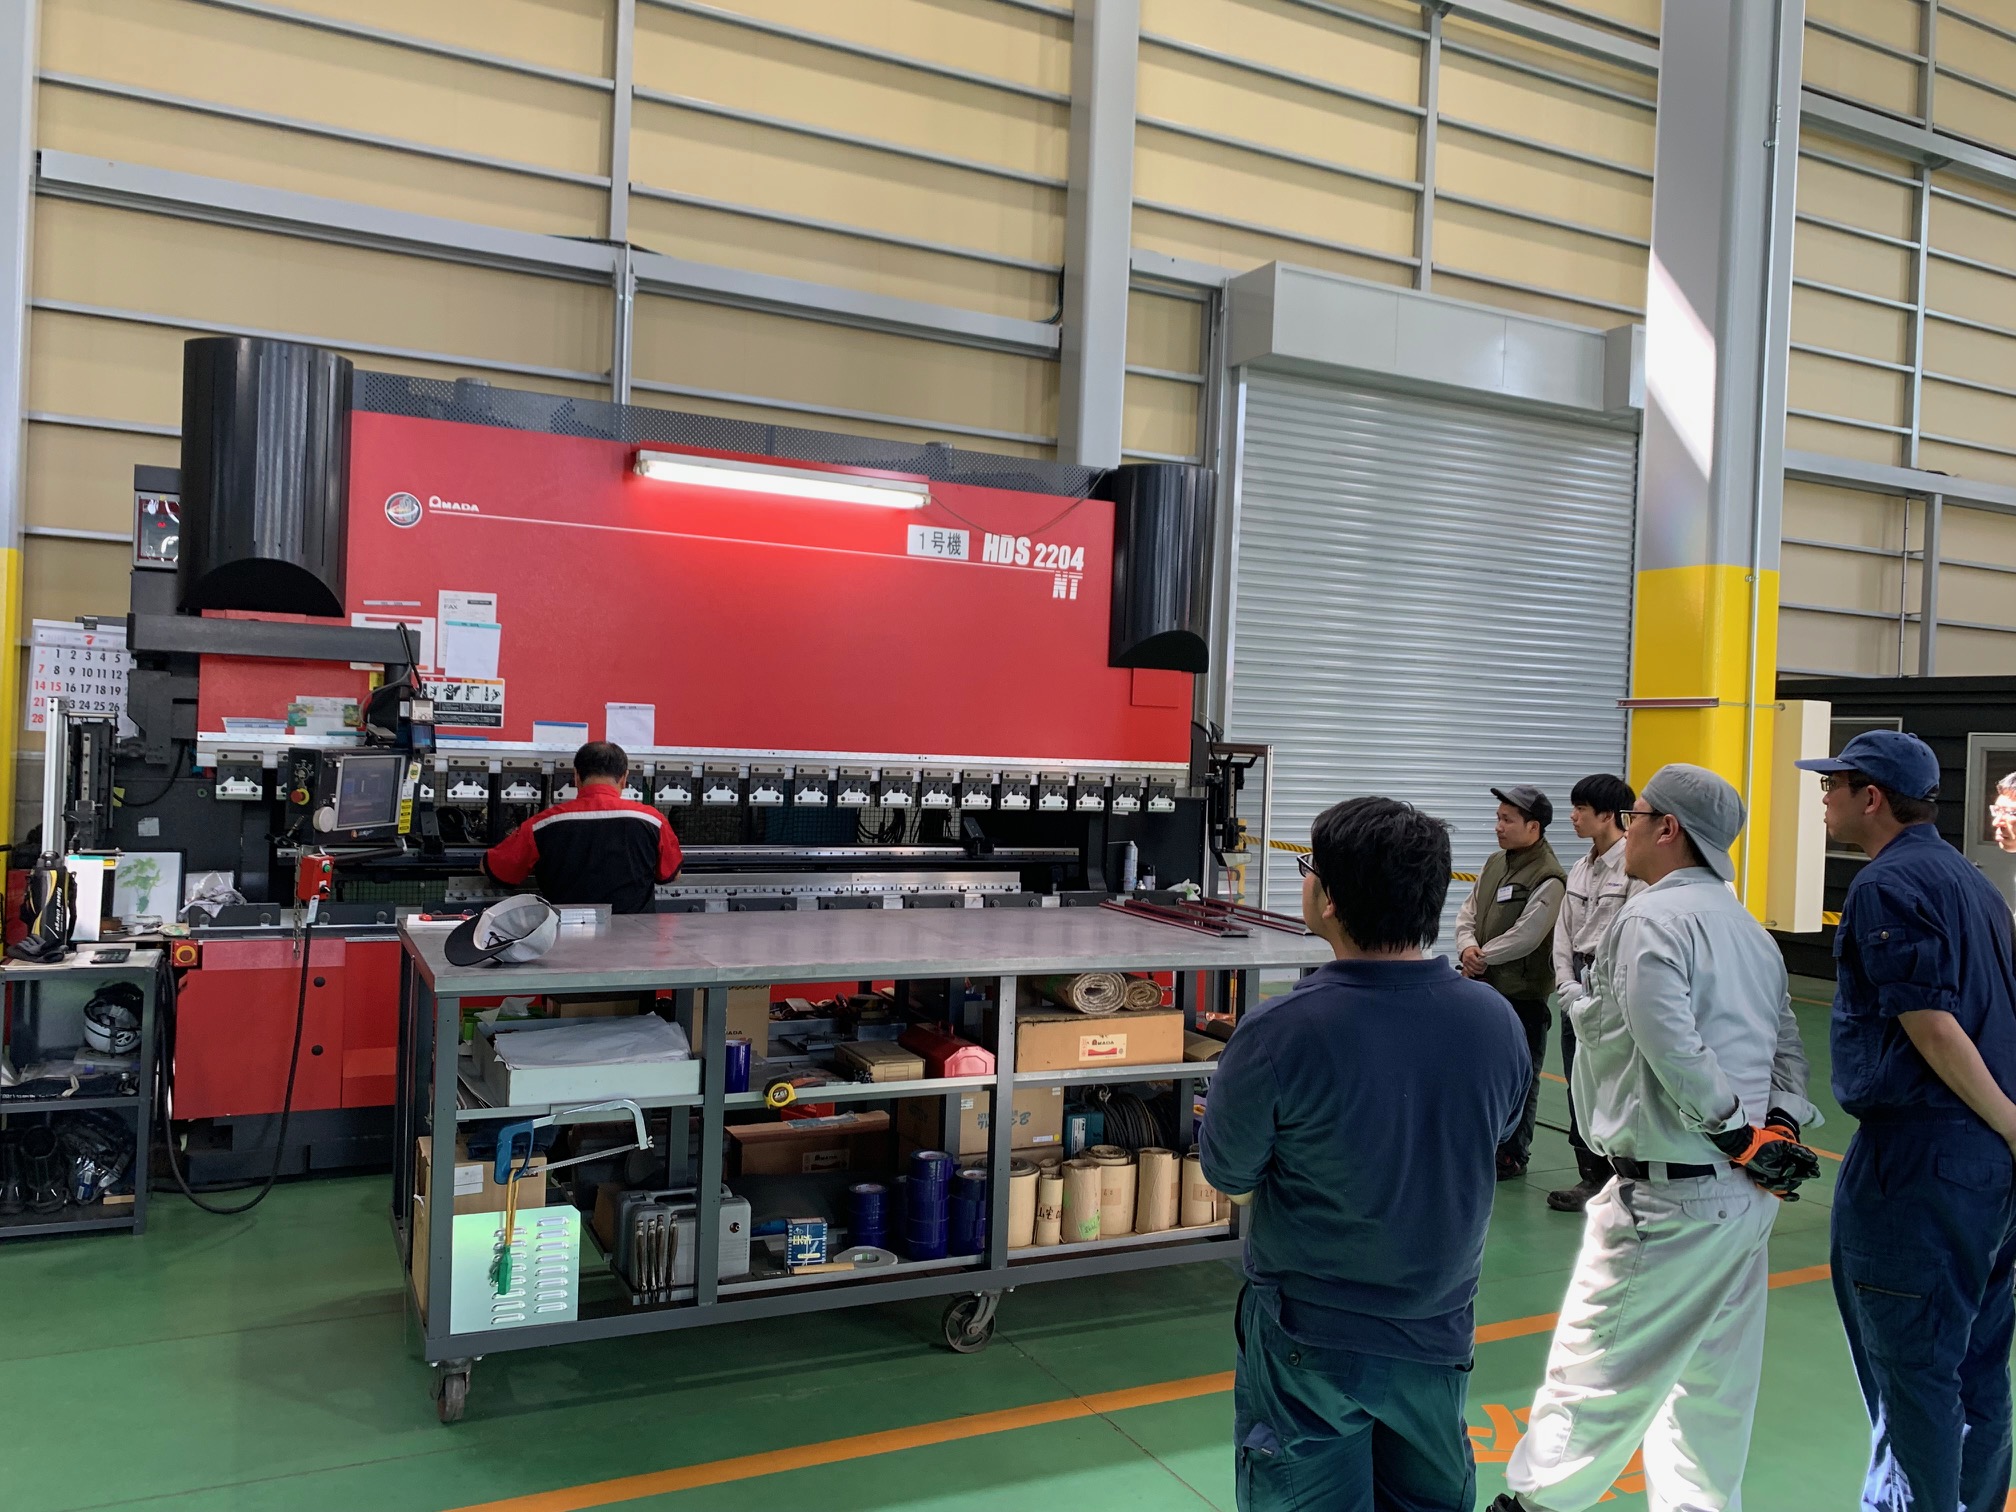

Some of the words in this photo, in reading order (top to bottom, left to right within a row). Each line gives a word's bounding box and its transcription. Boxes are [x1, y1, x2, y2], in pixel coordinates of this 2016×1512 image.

[982, 532, 1031, 566] HDS
[1033, 543, 1085, 571] 2204
[1052, 570, 1083, 600] NT
[84, 634, 96, 646] 7
[70, 650, 77, 660] 2
[85, 651, 92, 661] 3
[100, 652, 106, 662] 4
[115, 654, 121, 664] 5
[38, 664, 45, 673] 7
[53, 665, 60, 675] 8
[69, 666, 75, 676] 9
[82, 667, 93, 677] 10
[97, 668, 107, 678] 11
[111, 669, 122, 680] 12
[34, 680, 46, 690] 14
[50, 681, 62, 692] 15
[65, 682, 77, 693] 16
[80, 684, 92, 694] 17
[95, 685, 106, 695] 18
[110, 685, 121, 696] 19
[33, 697, 45, 707] 21
[79, 700, 91, 710] 24
[93, 701, 106, 711] 25
[108, 702, 120, 712] 26
[31, 713, 44, 724] 28
